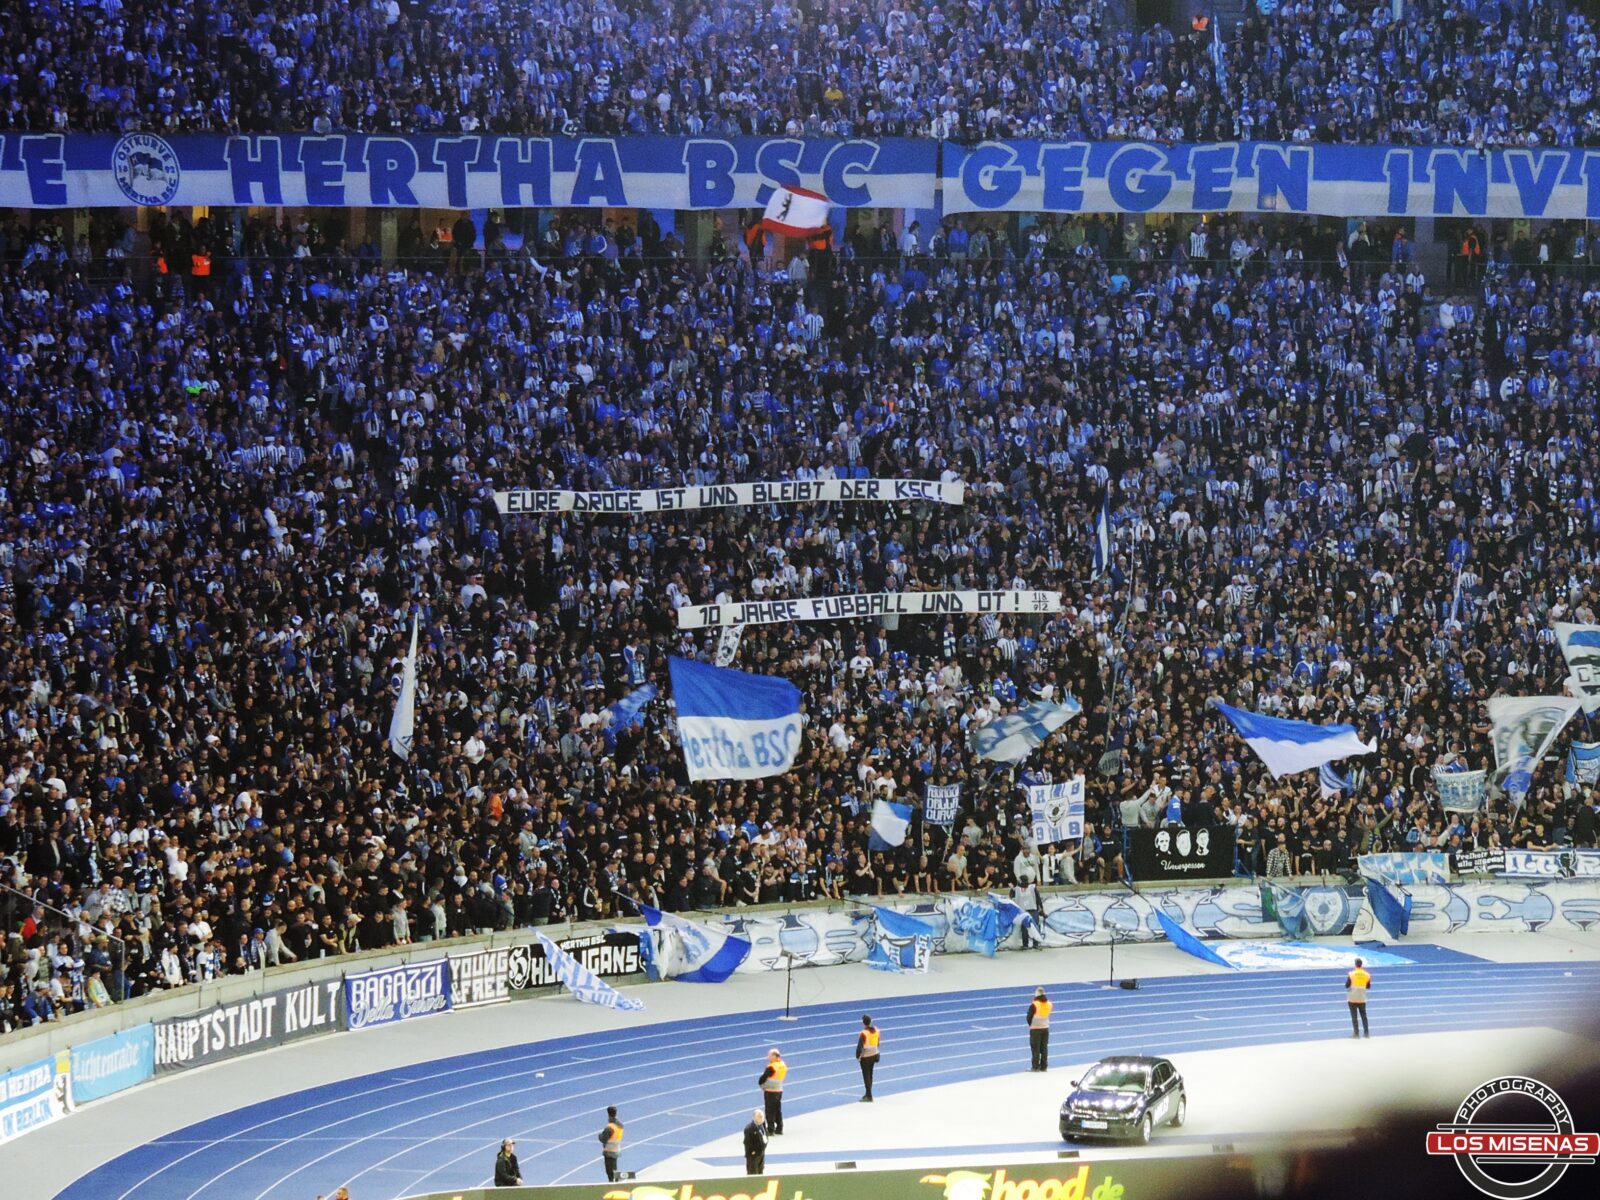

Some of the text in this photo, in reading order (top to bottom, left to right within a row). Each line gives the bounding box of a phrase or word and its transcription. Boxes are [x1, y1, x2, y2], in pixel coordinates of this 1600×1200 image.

[117, 134, 172, 162] OSTKURVE
[223, 134, 628, 209] HERTHA
[682, 138, 881, 210] BSC
[960, 141, 1314, 213] GEGEN
[507, 480, 944, 512] EURE DROGE IST UND BLEIBT DER KSC!
[699, 605, 721, 626] 10
[733, 601, 801, 624] JAHRE
[922, 593, 963, 613] UND
[450, 950, 509, 979] YOUNG
[154, 980, 342, 1065] HAUPTSTADT KULT
